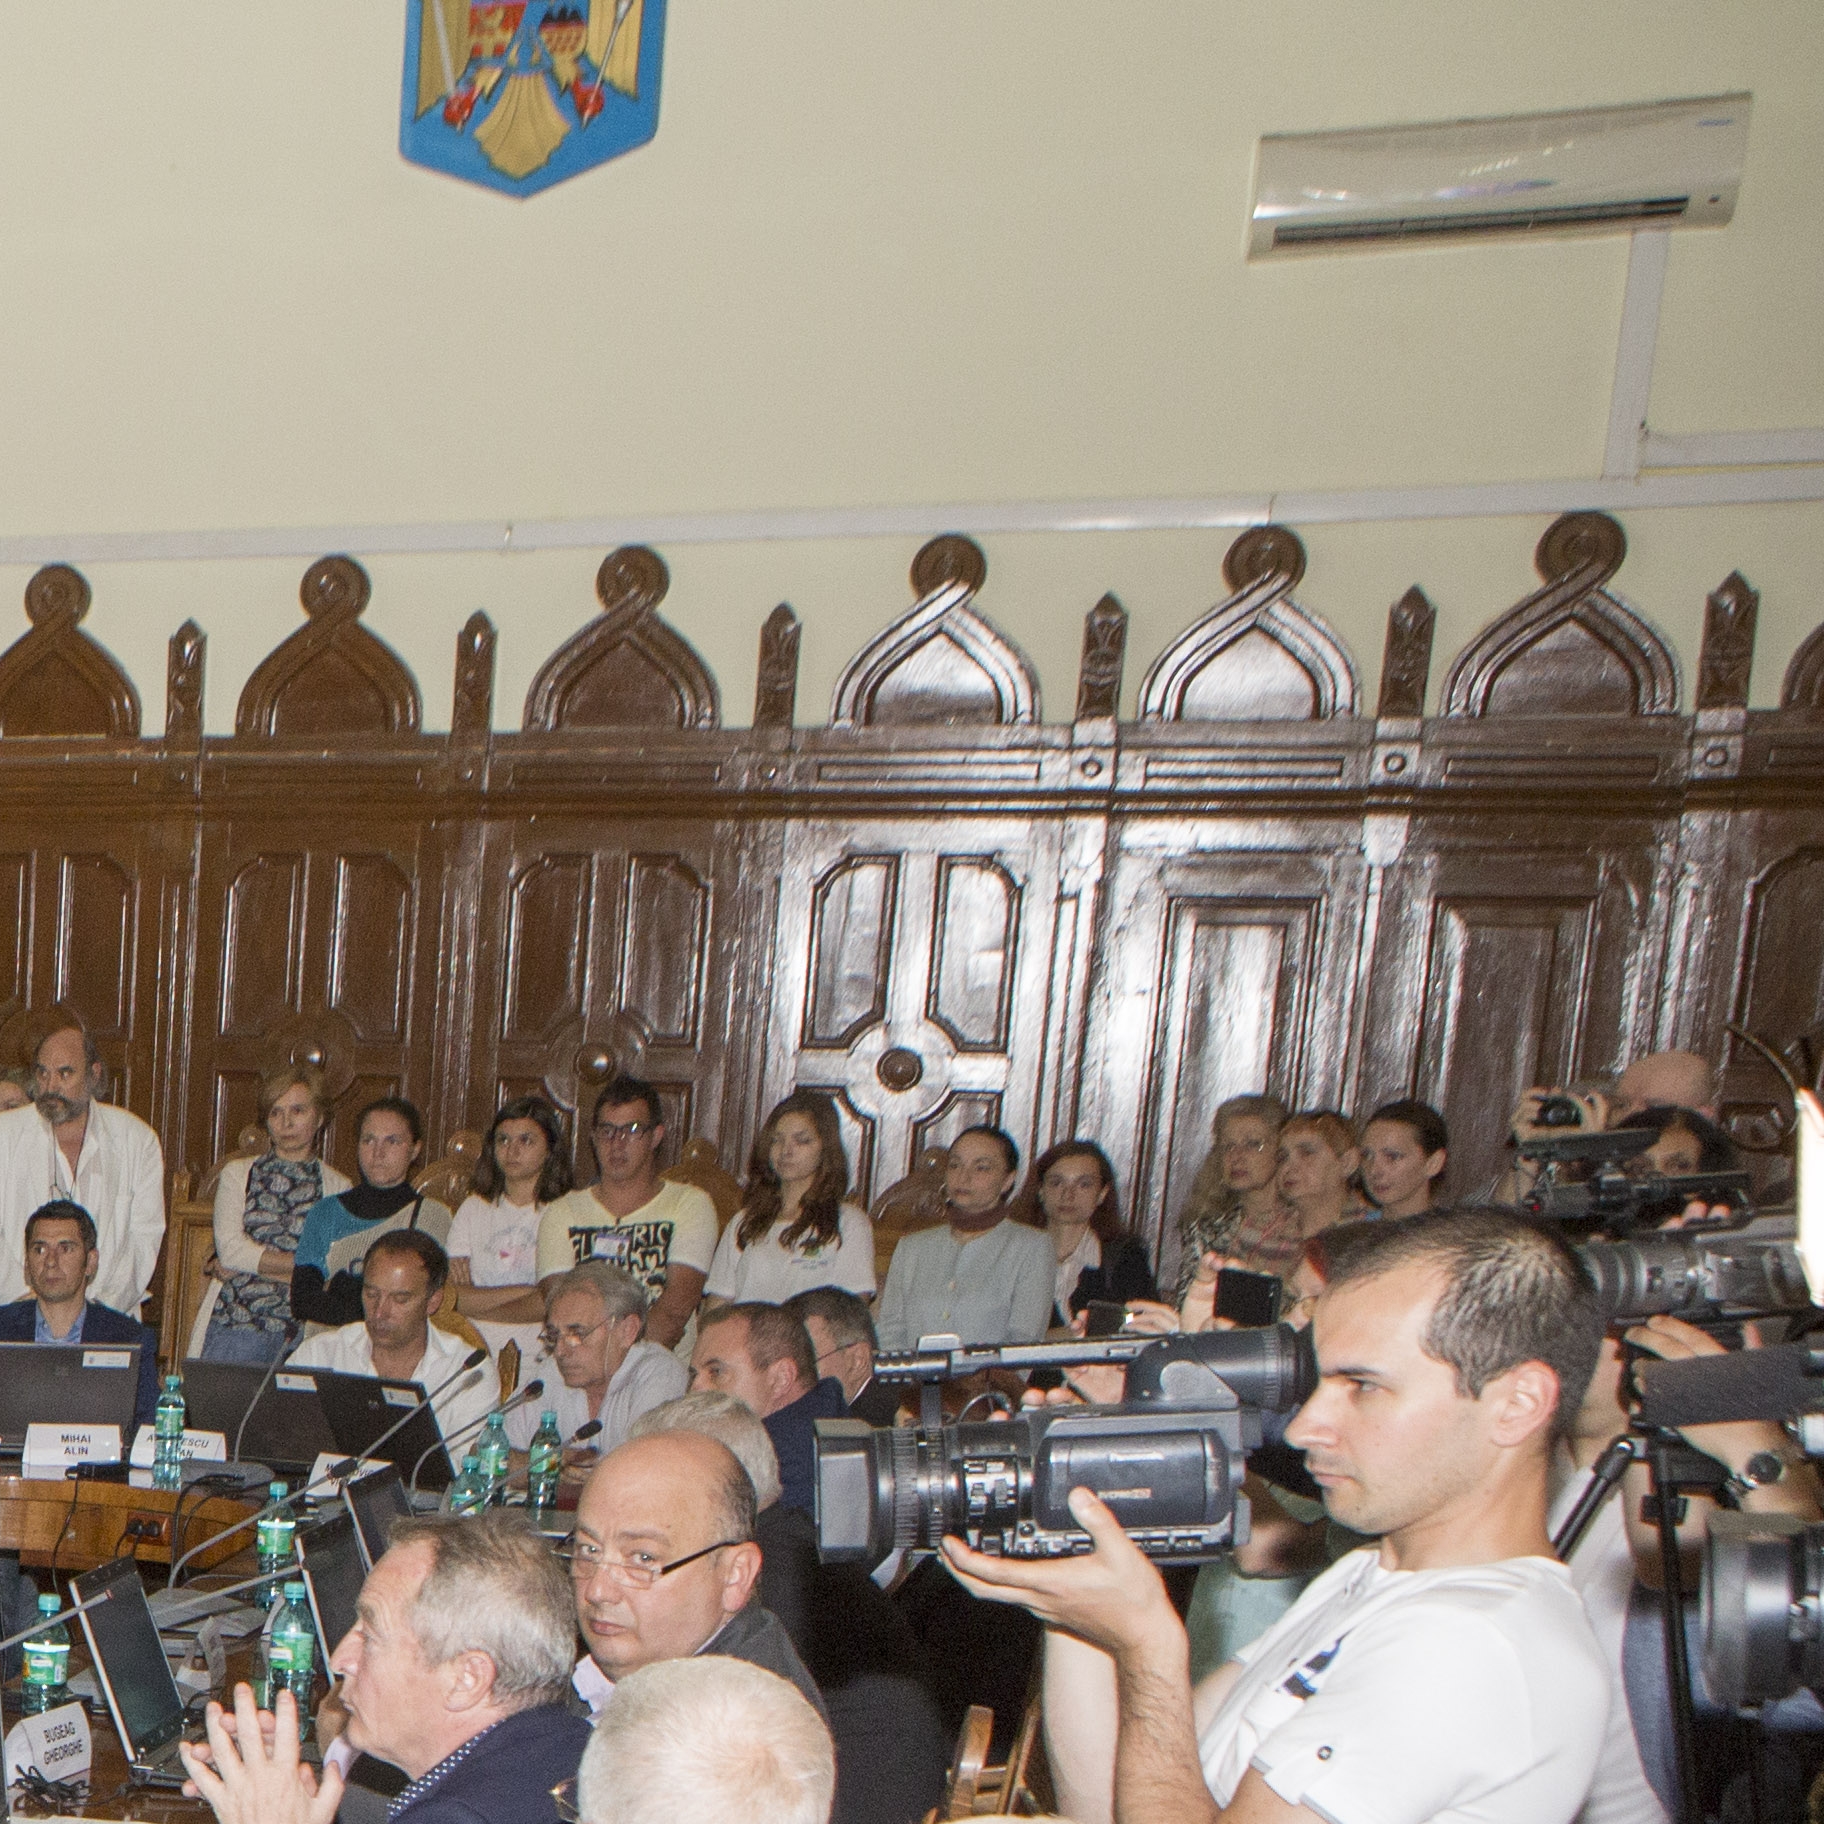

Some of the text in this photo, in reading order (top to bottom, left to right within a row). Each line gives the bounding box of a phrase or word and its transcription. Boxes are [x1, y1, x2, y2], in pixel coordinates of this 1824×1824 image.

[60, 1434, 91, 1444] MIHAI
[63, 1446, 89, 1455] ALIN
[44, 1738, 83, 1765] GHEORGHE
